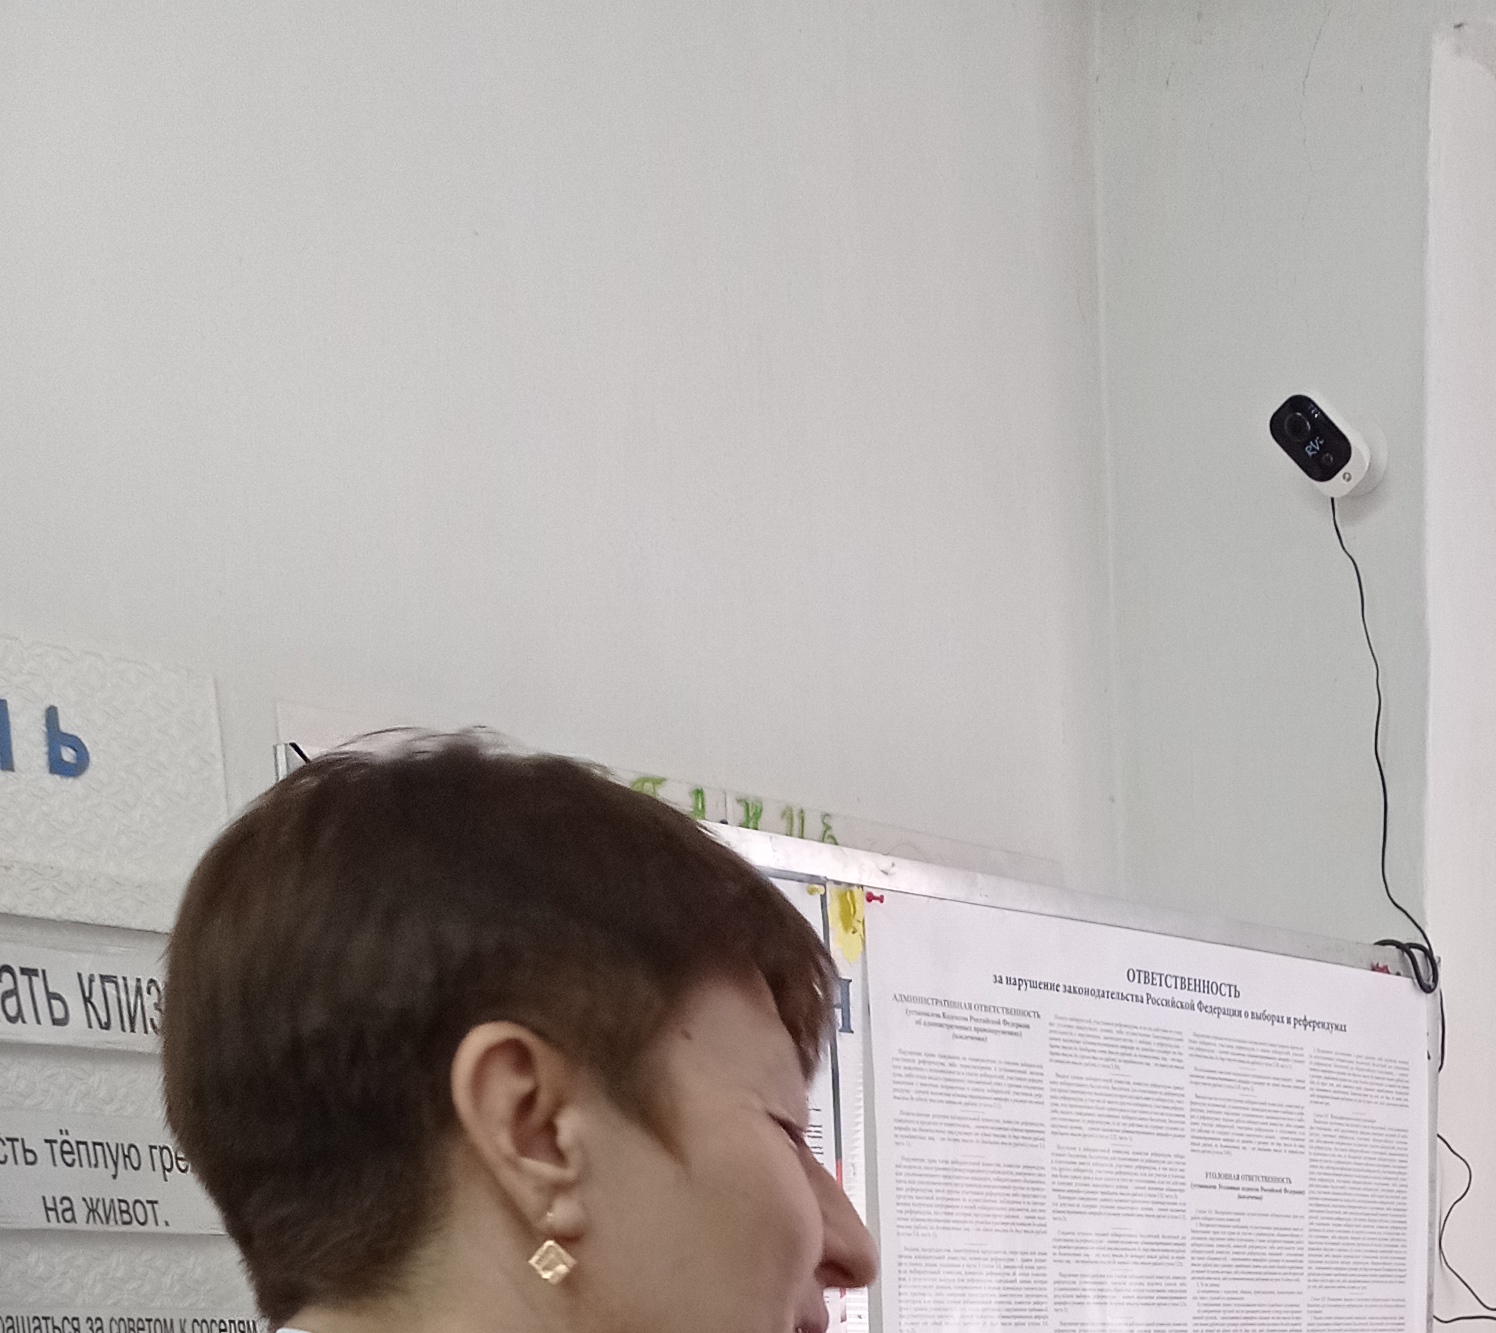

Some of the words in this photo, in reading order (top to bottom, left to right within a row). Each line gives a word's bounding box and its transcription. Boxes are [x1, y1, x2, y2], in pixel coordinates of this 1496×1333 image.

[992, 973, 1003, 985] за
[1005, 975, 1061, 993] нарушение
[1062, 983, 1145, 1003] законодательства
[1146, 992, 1195, 1012] Российской
[1196, 1000, 1242, 1019] Федерации
[1243, 1010, 1250, 1019] о
[1250, 1009, 1285, 1027] выборах
[1286, 1016, 1292, 1026] и
[1293, 1015, 1348, 1034] референдумах
[1126, 967, 1241, 998] ОТВЕТСТВЕННОСТЬ
[44, 1128, 142, 1180] тёплую
[41, 1195, 78, 1225] на
[81, 1196, 170, 1227] живот.
